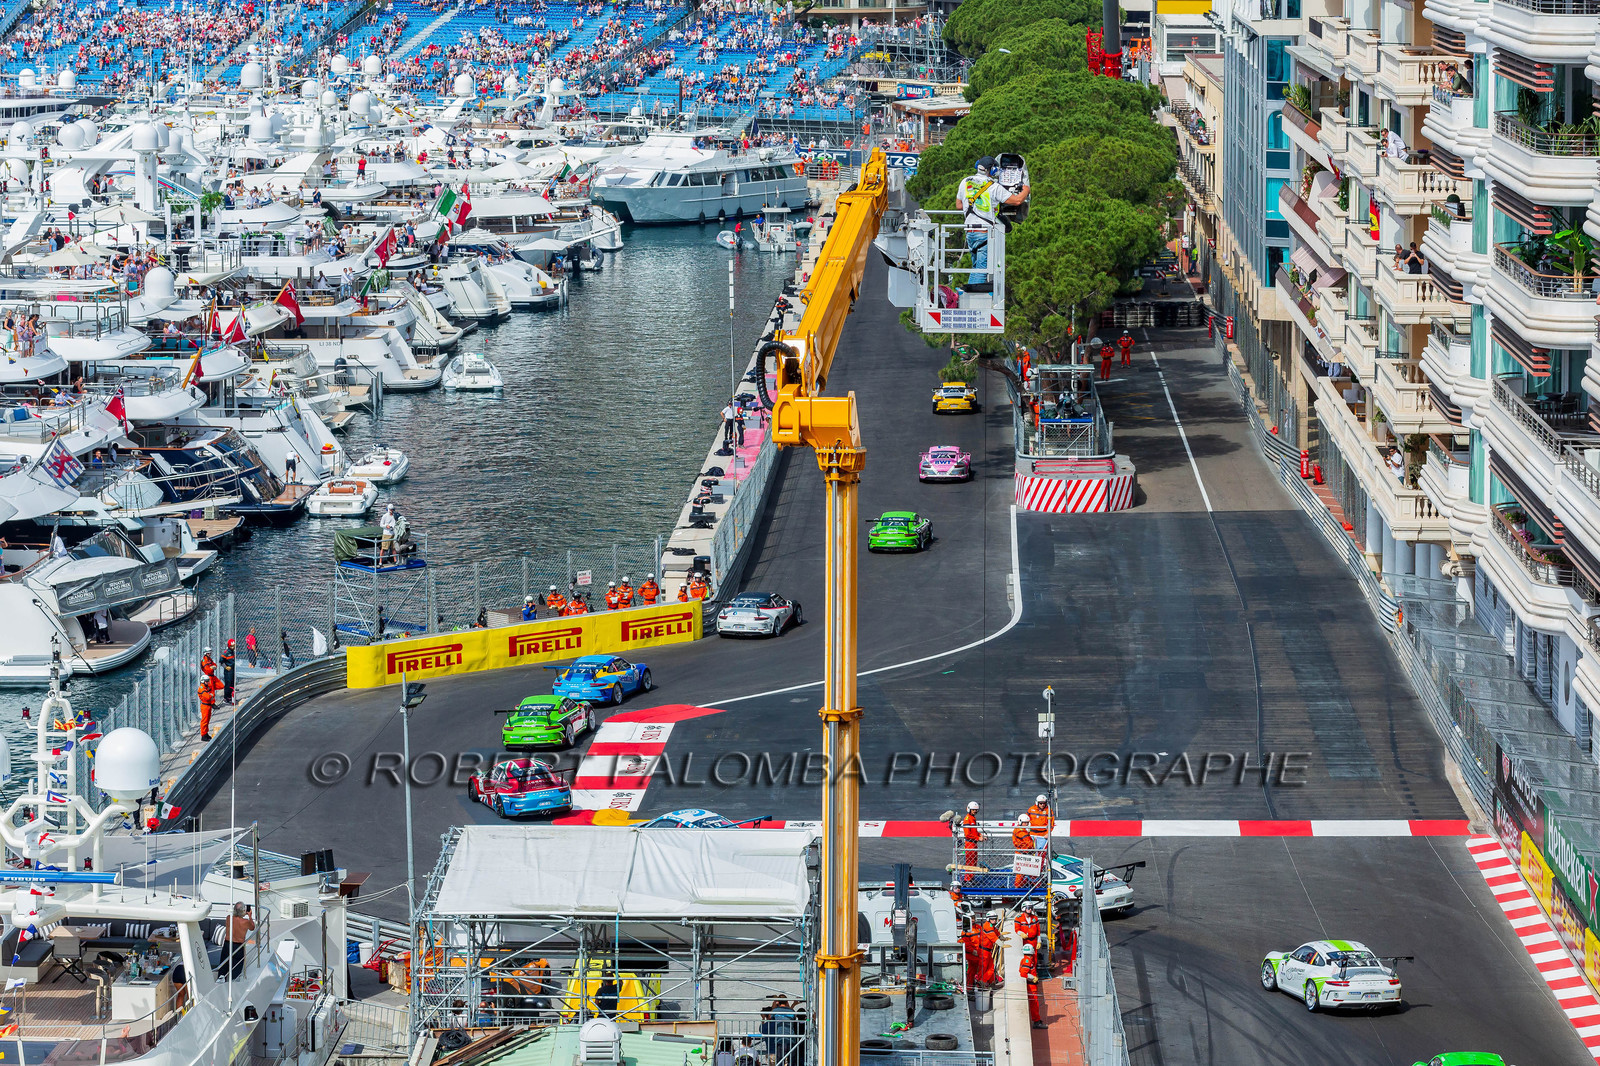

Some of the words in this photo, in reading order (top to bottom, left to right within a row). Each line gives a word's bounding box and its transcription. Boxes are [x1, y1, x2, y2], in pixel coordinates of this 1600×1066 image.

[509, 627, 582, 657] PIRELLI
[621, 612, 693, 642] PIRELLI
[387, 643, 463, 675] PIRELLI
[1548, 808, 1586, 906] Heineken
